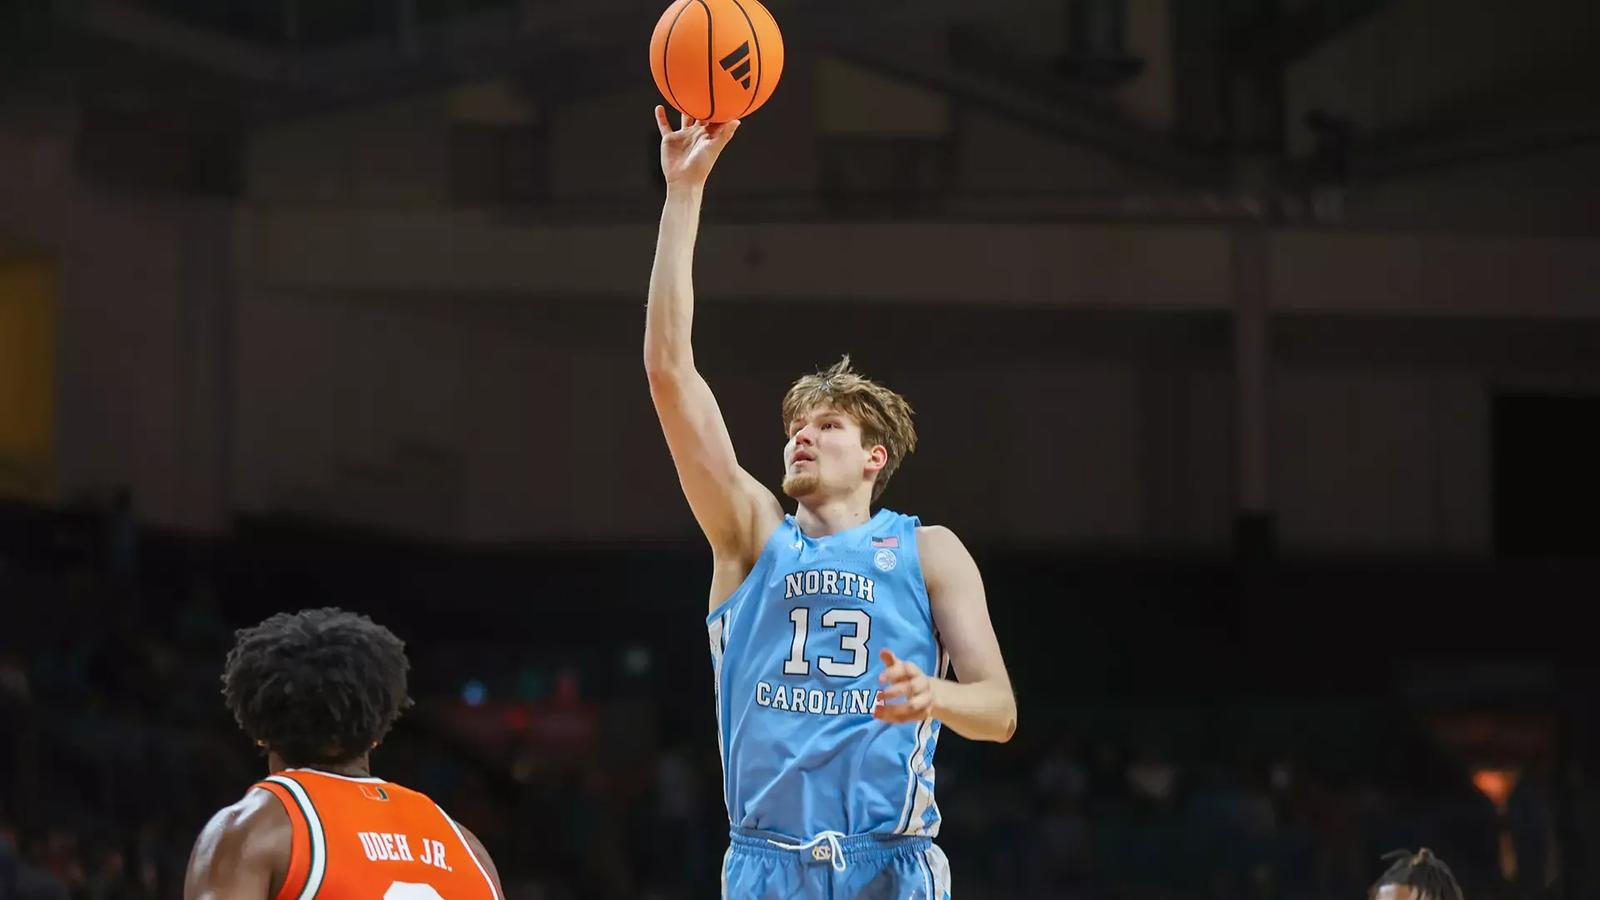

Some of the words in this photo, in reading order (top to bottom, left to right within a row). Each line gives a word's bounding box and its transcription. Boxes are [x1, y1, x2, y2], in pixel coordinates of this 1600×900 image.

[784, 569, 875, 603] NORTH
[783, 606, 872, 678] 13
[357, 831, 415, 861] UDEH
[420, 838, 453, 872] JR.
